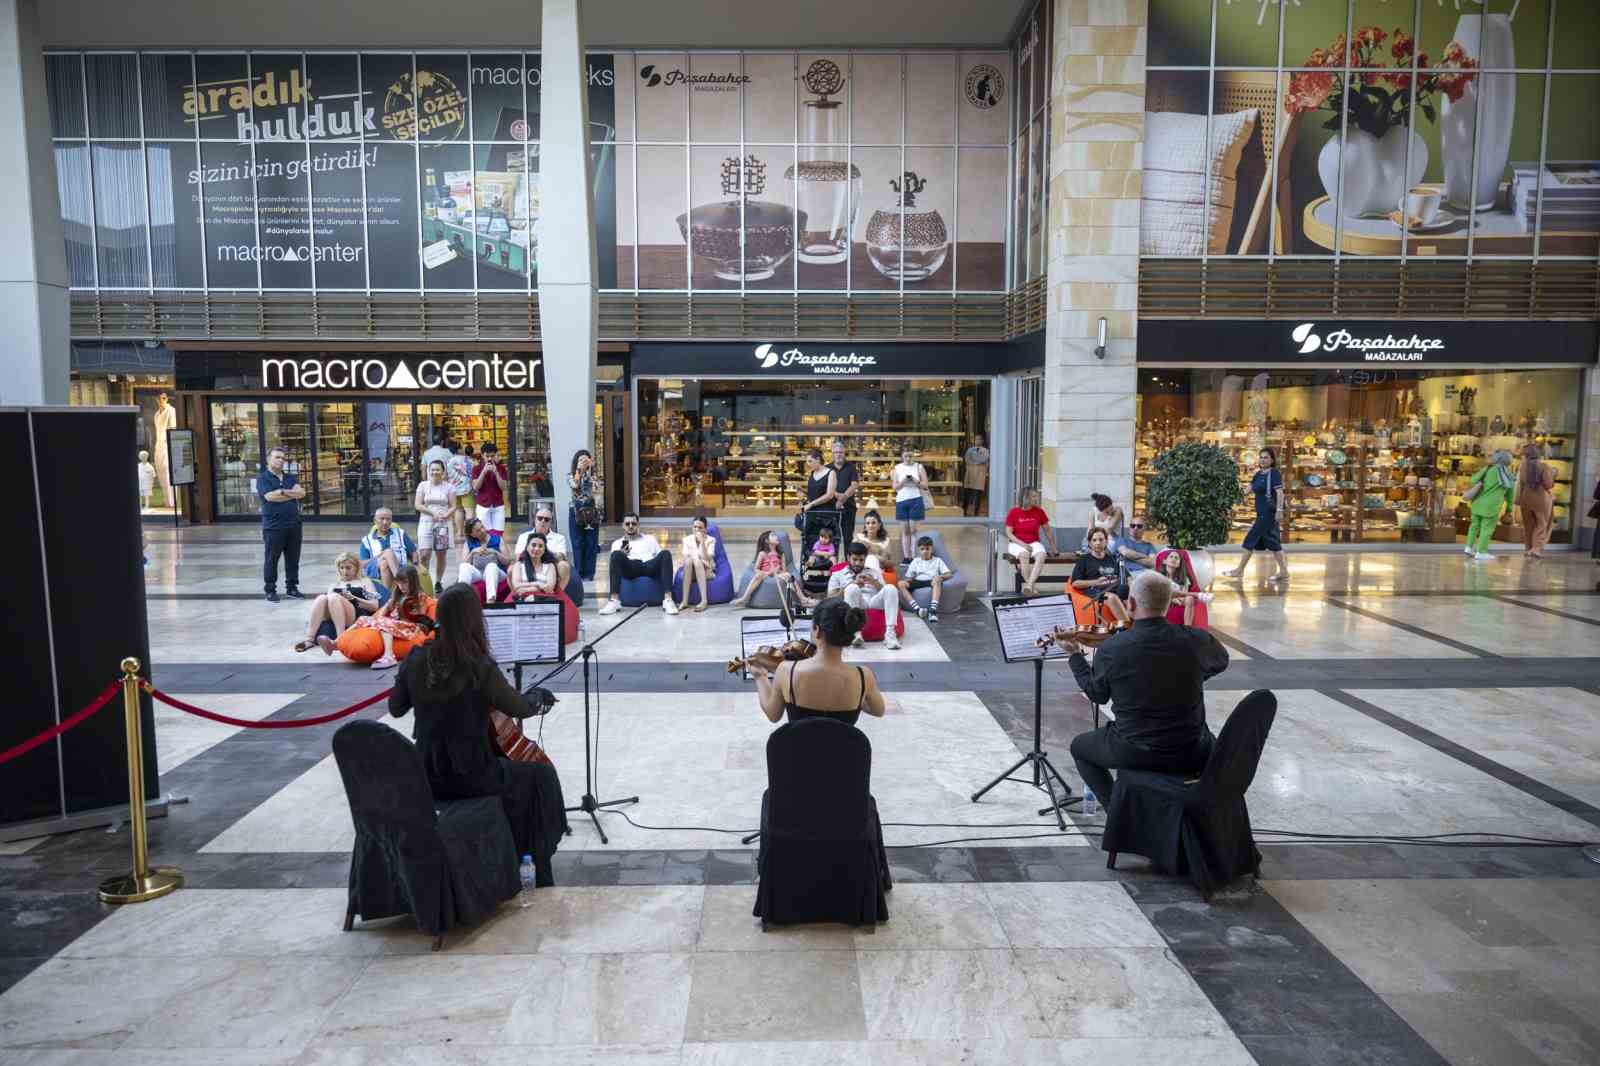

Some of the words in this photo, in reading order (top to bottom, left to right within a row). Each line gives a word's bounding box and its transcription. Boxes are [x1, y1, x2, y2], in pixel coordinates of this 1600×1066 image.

[182, 69, 315, 116] aradık
[423, 88, 468, 114] ÖZEL
[236, 101, 377, 141] bulduk
[187, 162, 240, 184] sizin
[286, 146, 378, 180] getirdik!
[1323, 329, 1445, 352] Paşabahçe
[780, 348, 877, 367] Paşabahçe
[1365, 351, 1424, 361] MAĞAZALARI
[814, 365, 860, 374] MAĞAZALARI
